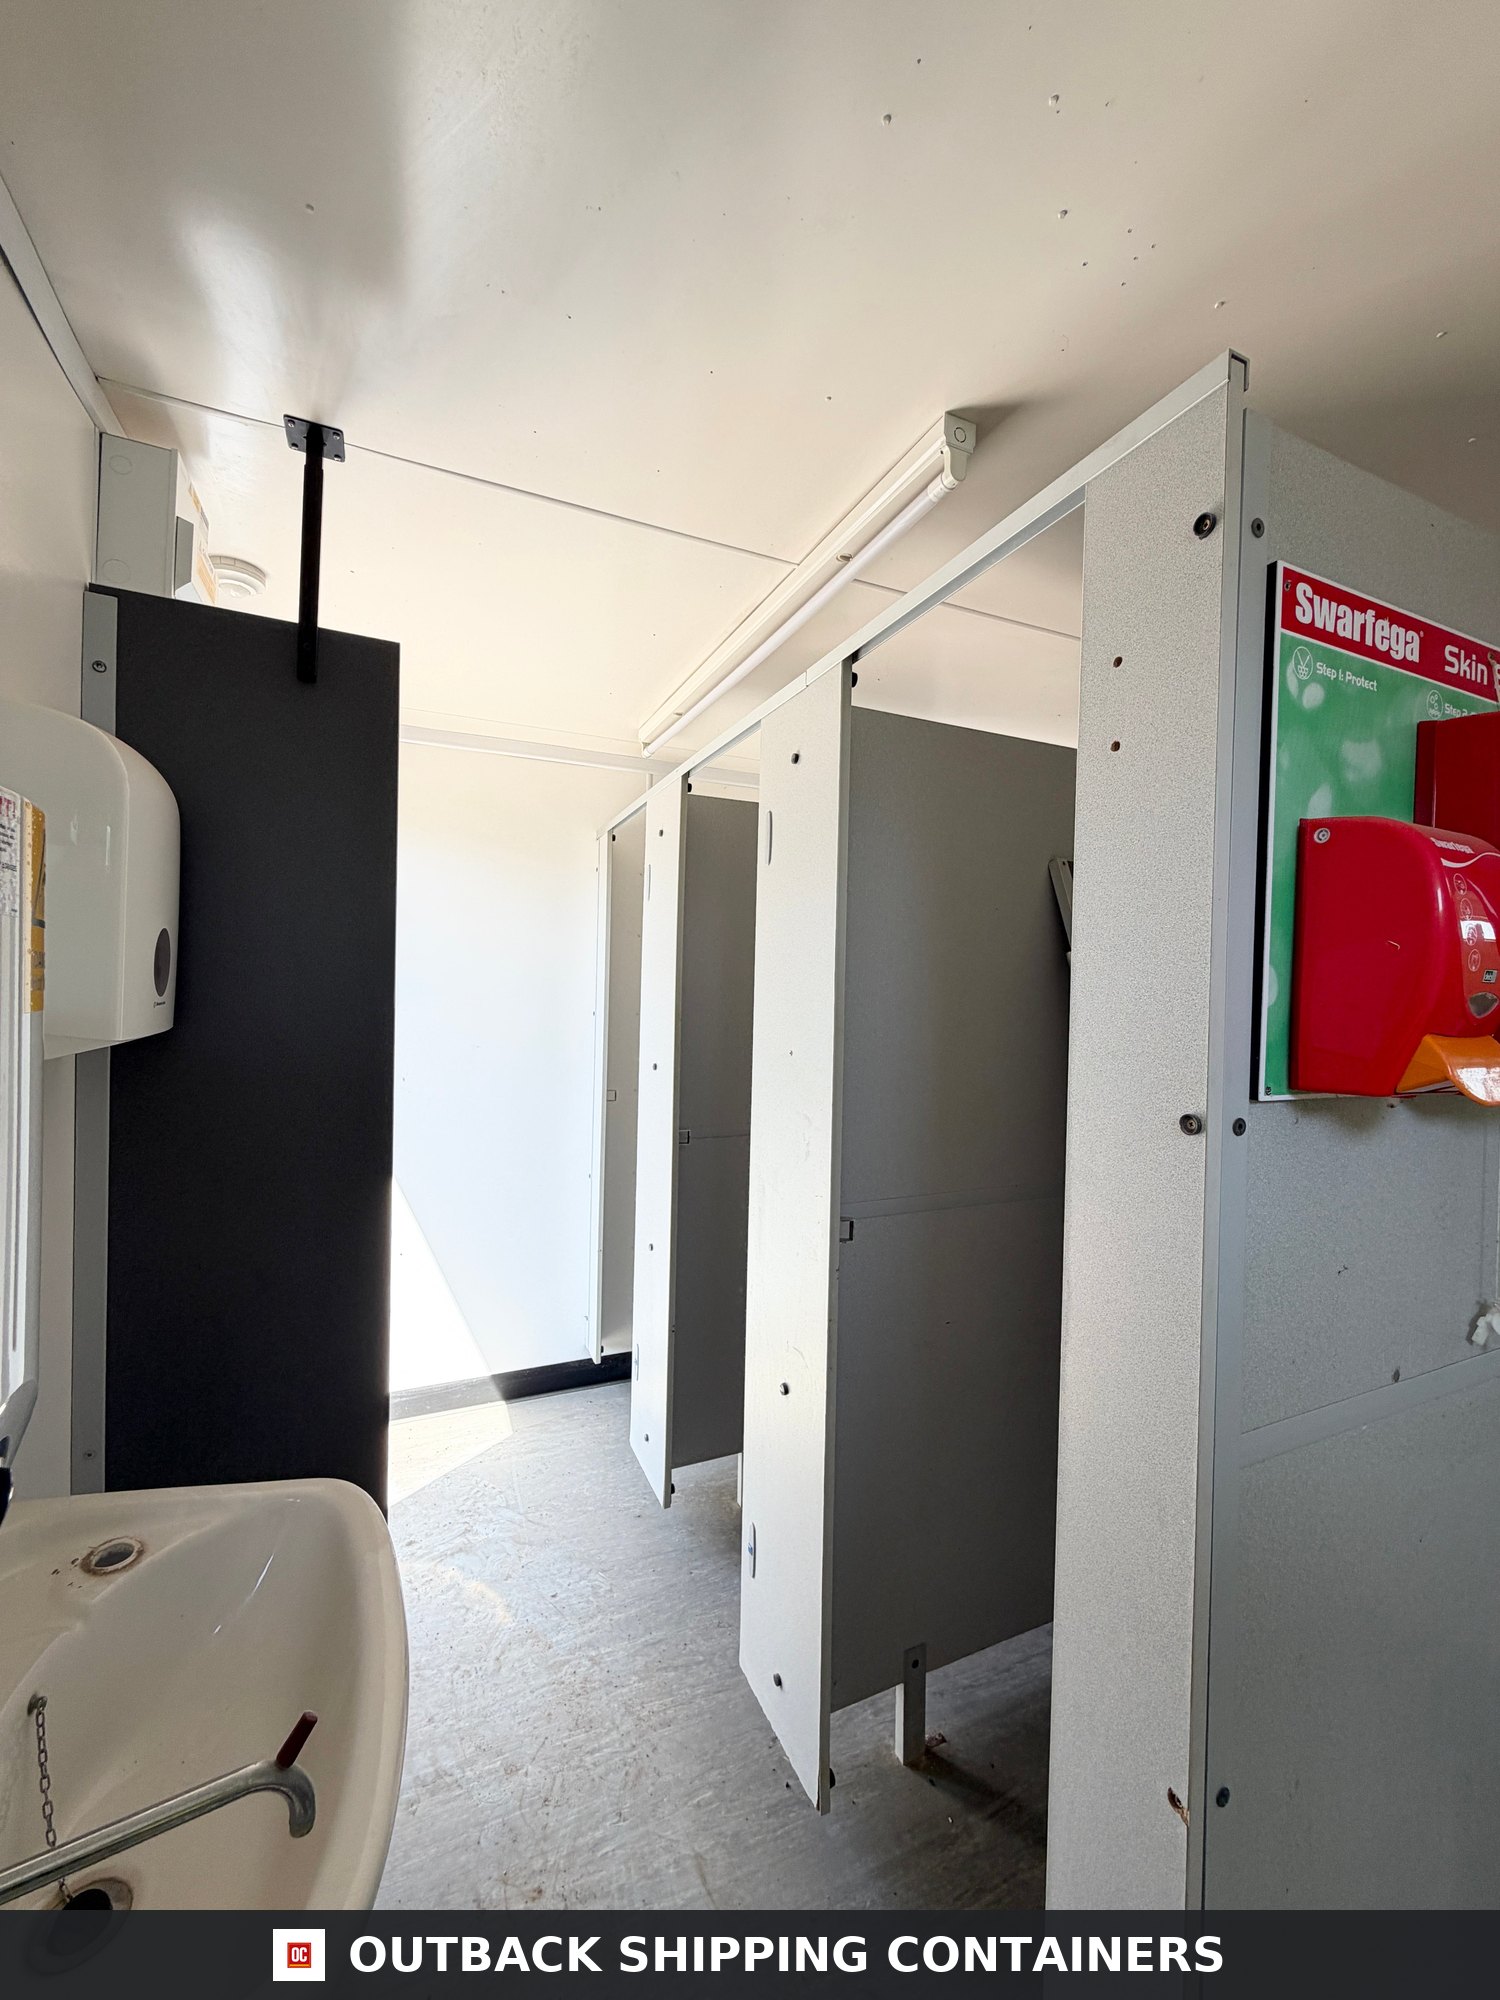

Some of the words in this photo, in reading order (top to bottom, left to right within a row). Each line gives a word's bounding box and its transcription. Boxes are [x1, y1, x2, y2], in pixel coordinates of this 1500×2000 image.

[1295, 582, 1420, 663] Swarfega
[1444, 644, 1488, 685] Skin
[1316, 662, 1337, 680] Step
[1345, 671, 1378, 691] Protect
